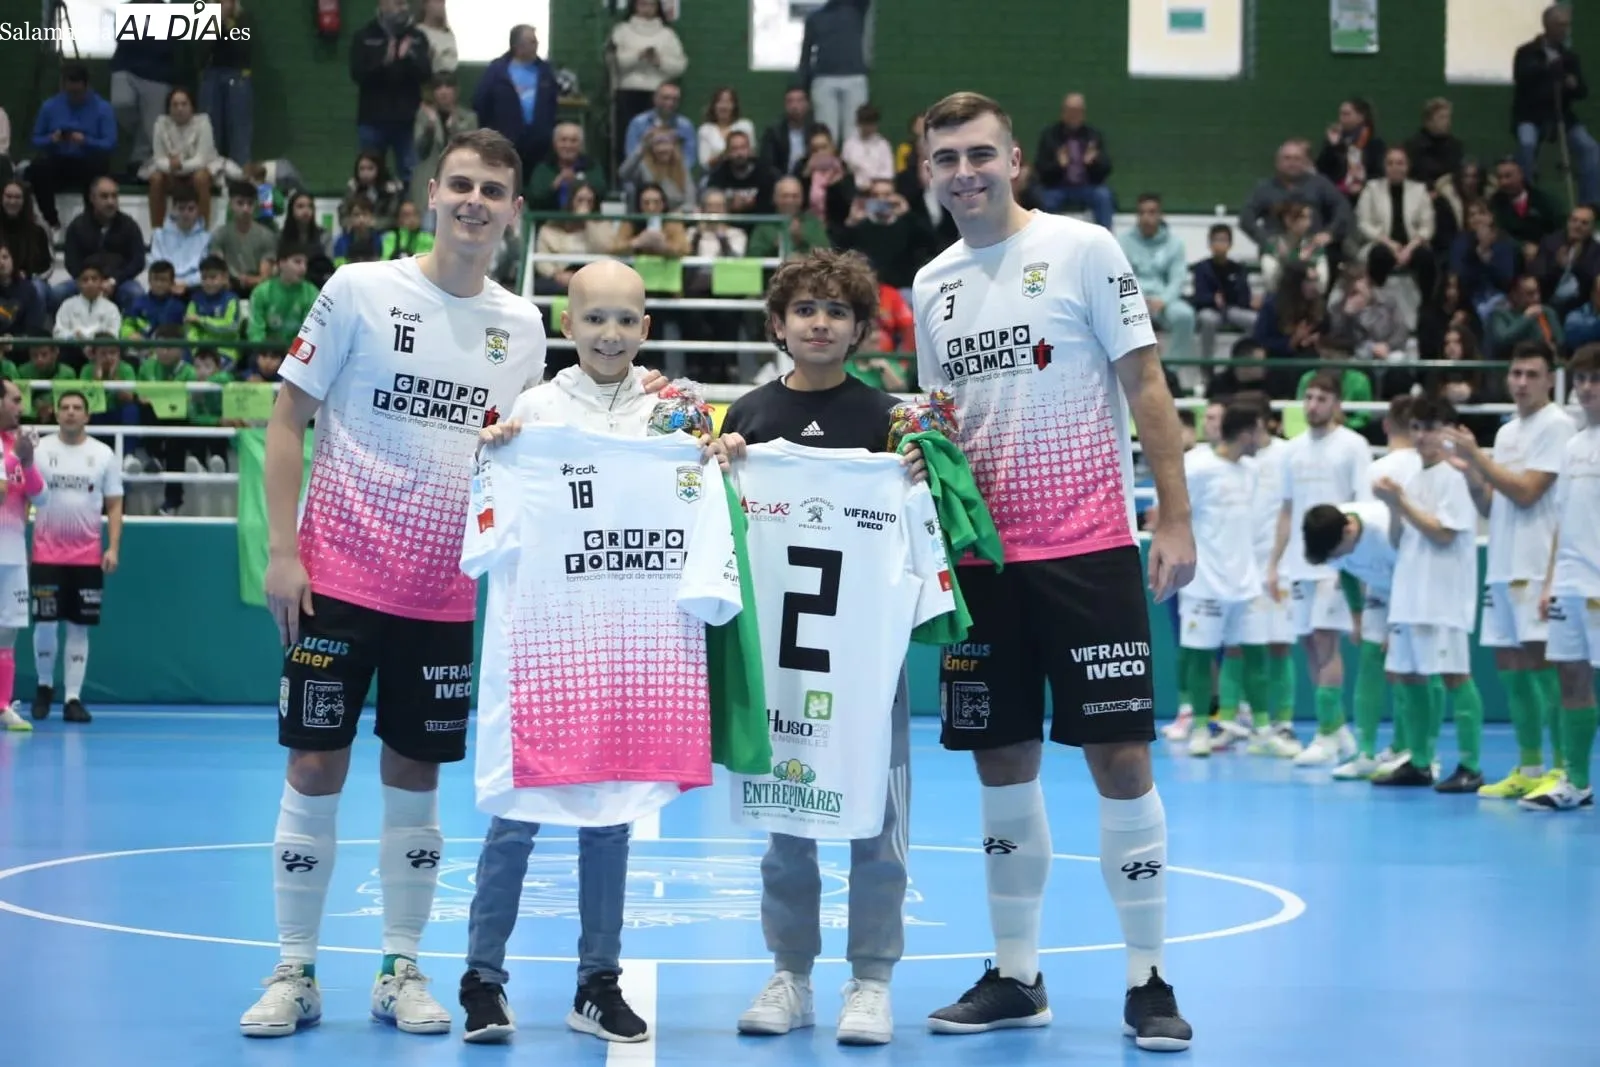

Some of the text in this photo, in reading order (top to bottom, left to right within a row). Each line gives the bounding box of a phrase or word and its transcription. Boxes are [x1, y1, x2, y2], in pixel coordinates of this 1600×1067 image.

[944, 294, 956, 321] 3
[393, 324, 415, 353] 16
[947, 325, 1030, 358] GRUPO
[393, 373, 489, 407] GRUPO
[568, 480, 594, 509] 18
[843, 507, 897, 523] VIFRAUTO
[856, 520, 883, 531] IVECO
[798, 524, 832, 532] PEUGEOT
[584, 529, 684, 550] GRUPO
[566, 571, 606, 583] formación
[607, 571, 633, 581] integral
[635, 571, 646, 580] de
[780, 546, 843, 673] 2
[291, 647, 334, 668] Ener
[1070, 641, 1150, 662] VIFRAUTO
[944, 655, 978, 671] Ener
[1086, 660, 1145, 680] IVECO
[743, 781, 842, 813] ENTREPINARES
